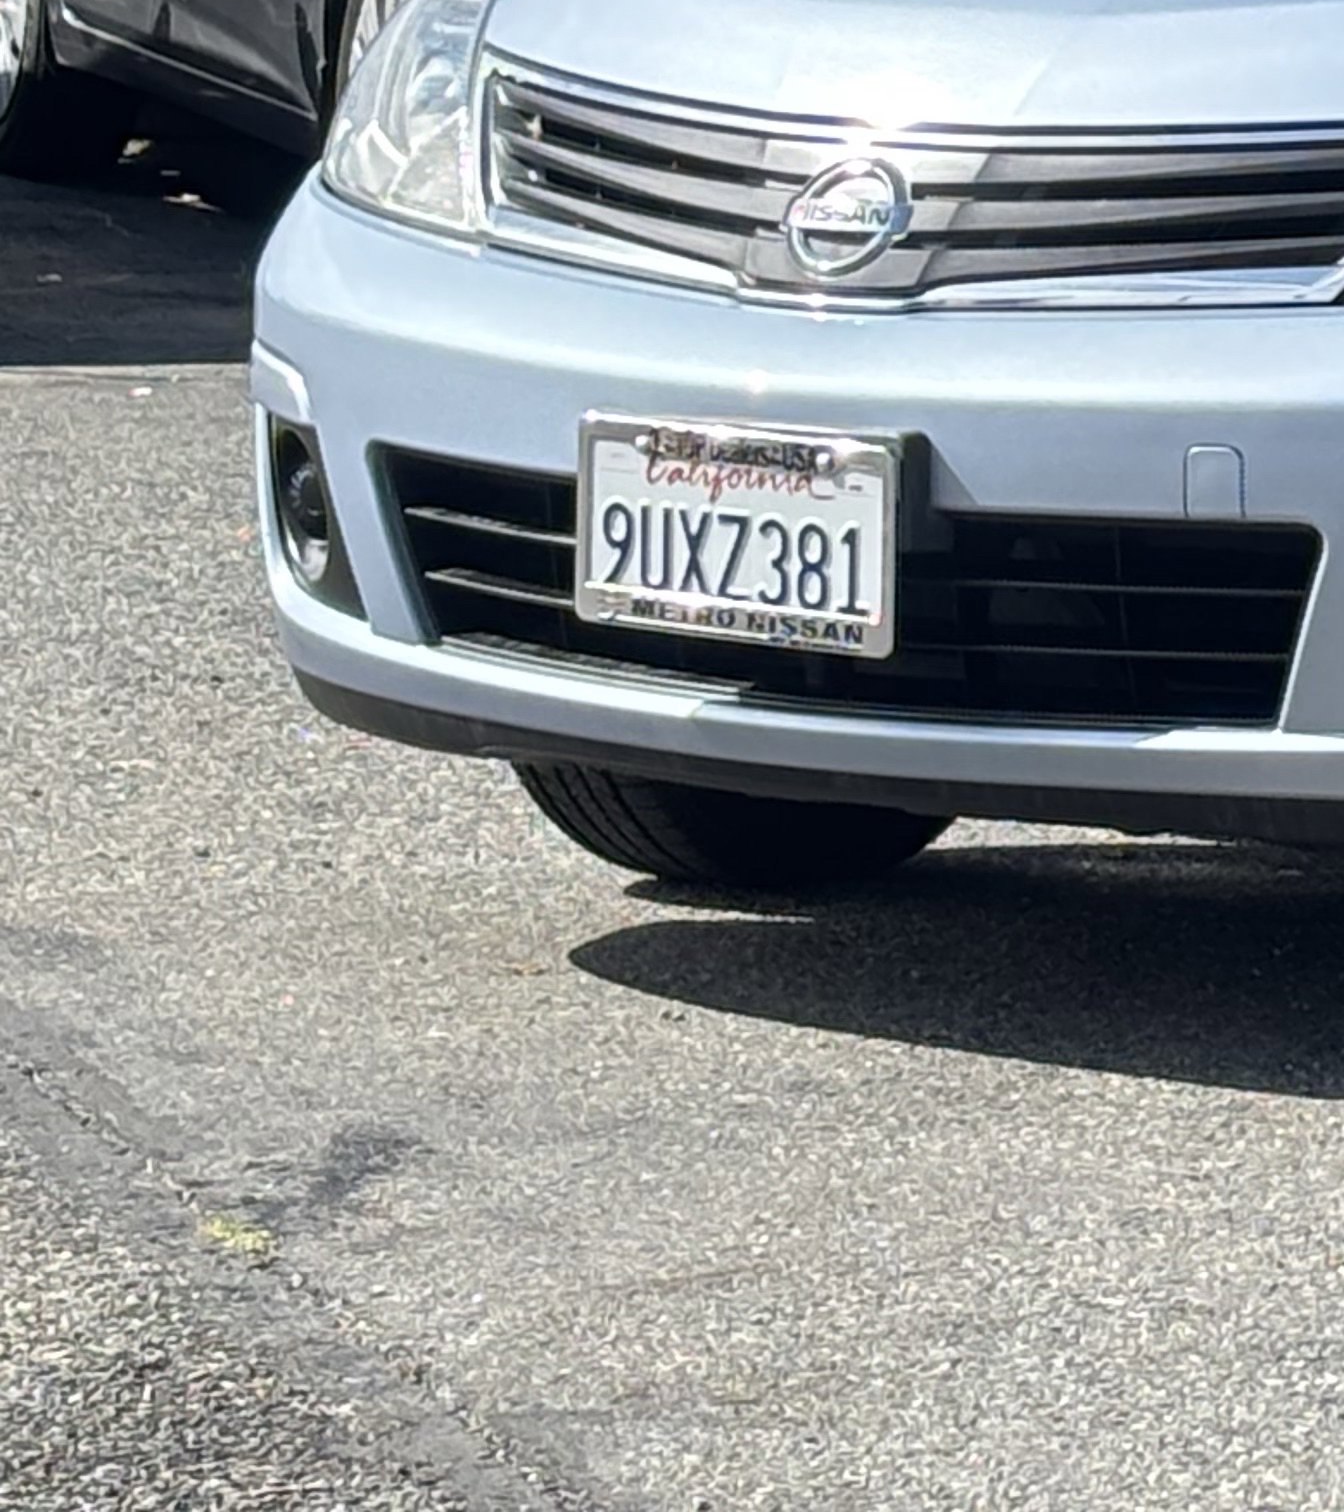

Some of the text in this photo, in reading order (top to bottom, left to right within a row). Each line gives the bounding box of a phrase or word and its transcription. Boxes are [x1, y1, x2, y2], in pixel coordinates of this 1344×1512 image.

[602, 501, 870, 617] 9UXZ381
[630, 597, 865, 643] METRO NISSAN
